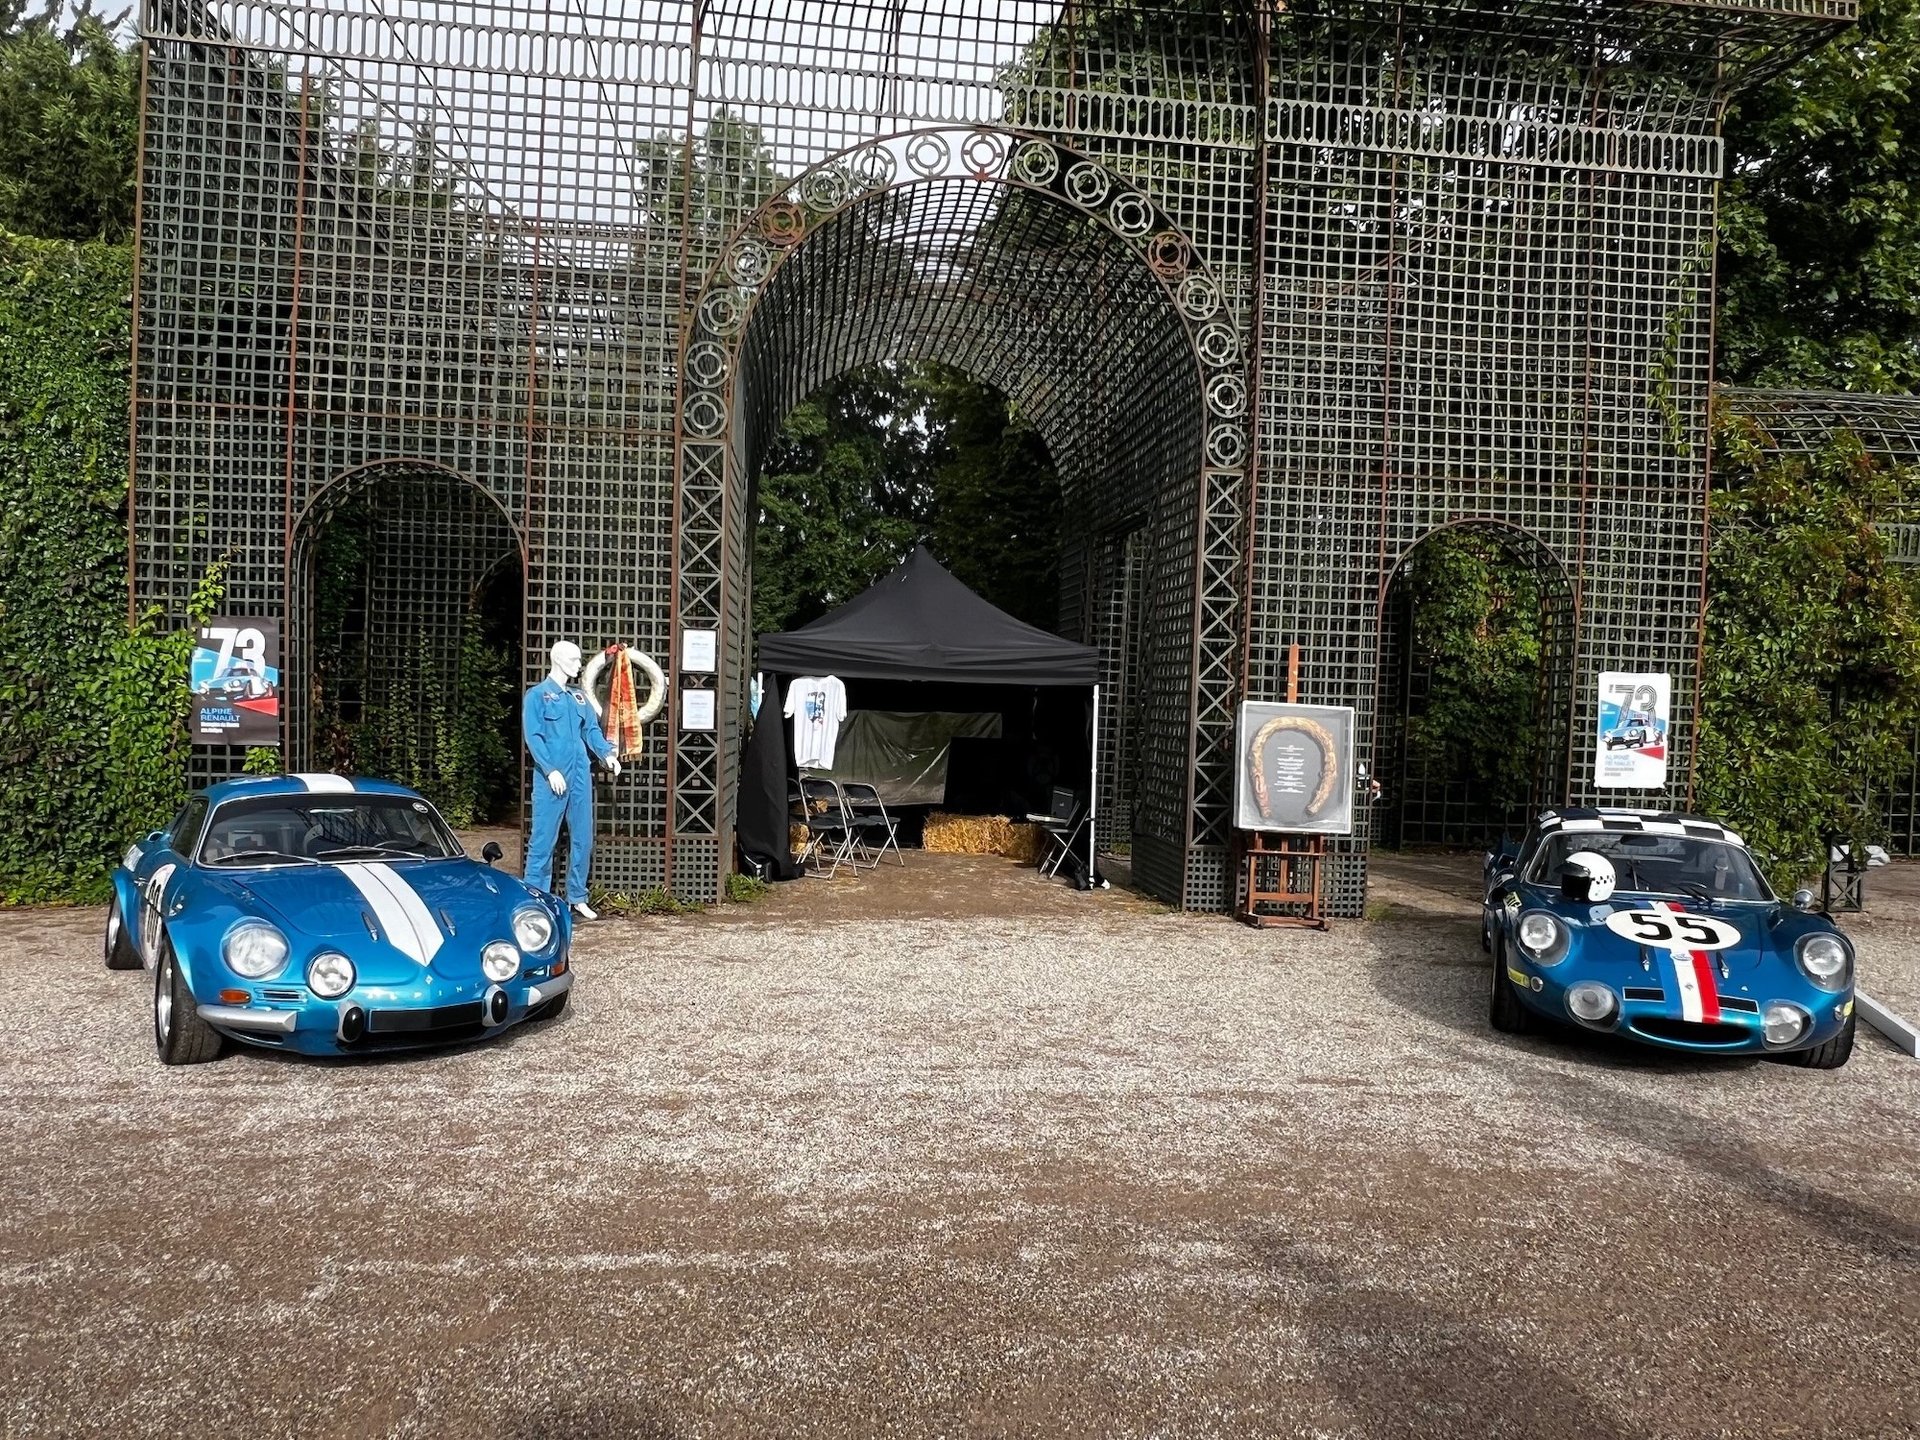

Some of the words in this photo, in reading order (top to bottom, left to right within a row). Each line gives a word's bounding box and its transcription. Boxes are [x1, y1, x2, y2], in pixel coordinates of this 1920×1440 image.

[202, 627, 265, 679] '73
[1609, 684, 1657, 728] '73
[1629, 913, 1720, 944] 55
